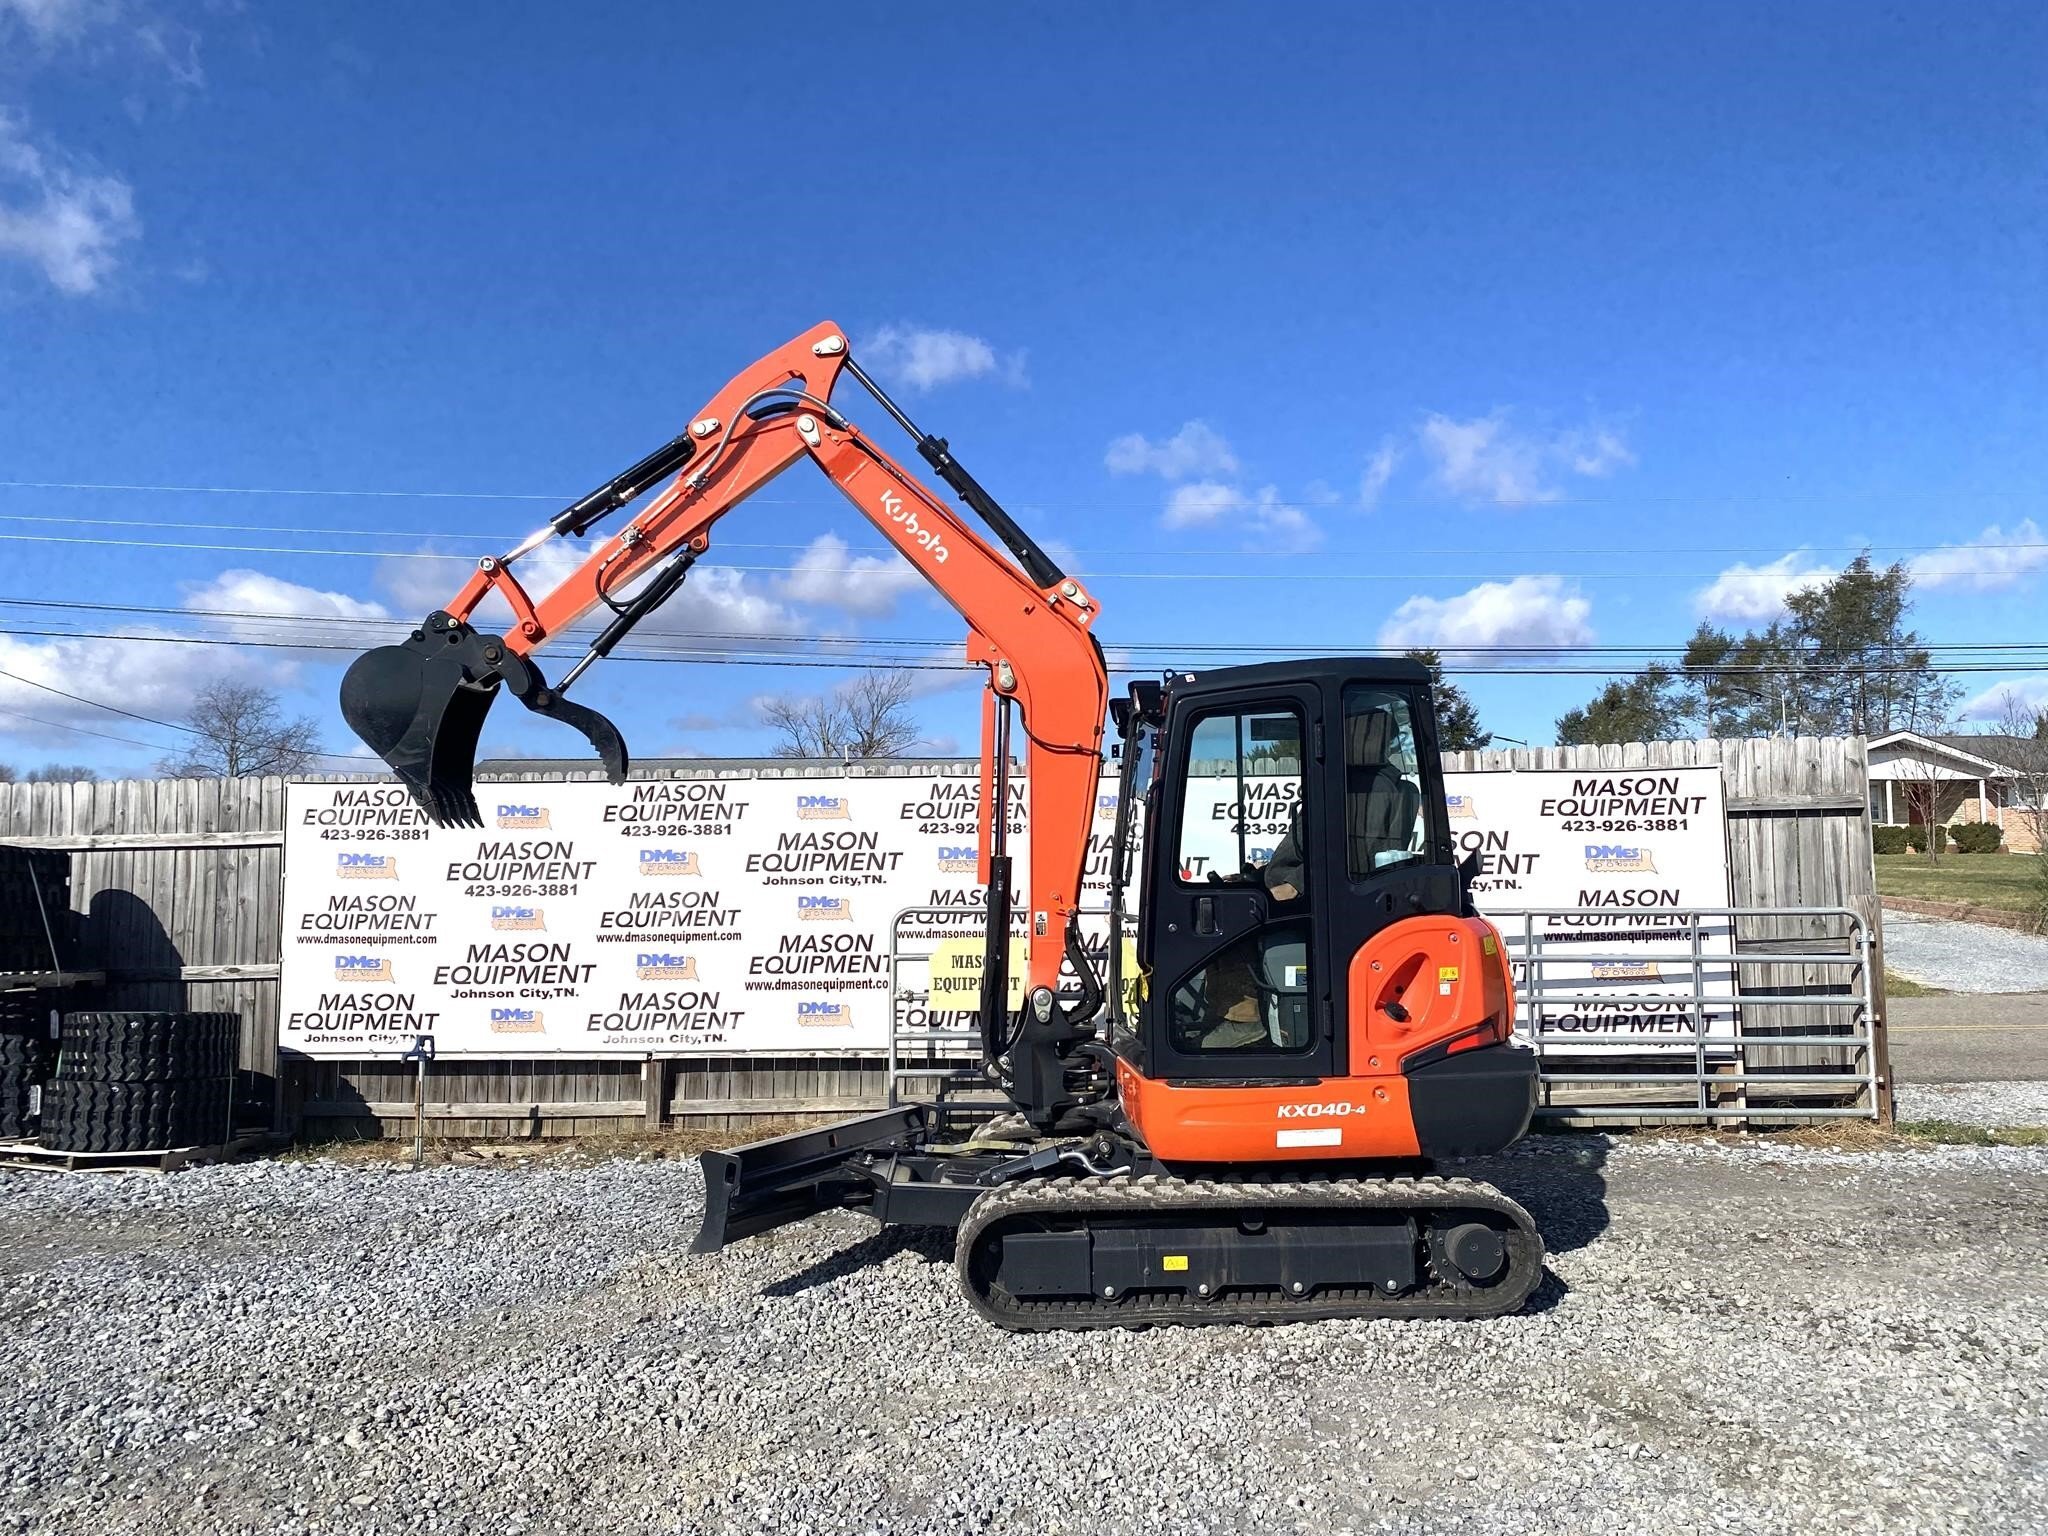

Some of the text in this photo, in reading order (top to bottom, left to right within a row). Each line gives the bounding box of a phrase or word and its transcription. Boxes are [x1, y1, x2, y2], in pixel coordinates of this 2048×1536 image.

[880, 488, 949, 564] Kubota
[633, 783, 726, 802] MASON
[929, 783, 1025, 801] MASN
[1573, 777, 1679, 796] MASON
[603, 801, 749, 822] EQUIPMENT
[1540, 797, 1707, 816] EQUIPMENT
[303, 809, 430, 826] EQUIPMEN
[1562, 819, 1687, 831] 423-926-3881
[320, 829, 428, 840] 423-926-3881
[621, 824, 731, 836] 423-926-3881
[777, 832, 878, 851] MASON
[477, 842, 573, 860] MASON
[938, 847, 978, 860] DMe
[746, 849, 903, 872] EQUIPMENT
[447, 859, 597, 881] EQUIPMENT
[762, 876, 823, 885] Johnson
[465, 884, 577, 896] 423-926-3881
[929, 889, 1021, 906] MASN
[1578, 889, 1680, 906] MASON
[328, 896, 416, 911] MASON
[629, 891, 719, 908] MASON
[301, 914, 437, 930] EQUIPMENT
[600, 910, 741, 928] EQUIPMENT
[297, 934, 436, 947] www.dmasonequipment.com
[596, 931, 741, 944] www.dmasonequipment.com
[779, 934, 874, 953] MASON
[1543, 930, 1710, 943] www.dmasonequipment.cm
[467, 943, 570, 963] MASON
[434, 962, 597, 984] EQUIPMENT
[451, 989, 514, 998] Johnson
[743, 977, 889, 993] www.dmasonequipment.co
[318, 994, 415, 1011] MASON
[619, 992, 720, 1010] MASON
[288, 1013, 440, 1030] EQUIPMENT
[587, 1012, 745, 1031] EQUIPMENT
[304, 1034, 363, 1042] Johnson
[603, 1034, 663, 1045] Johnson
[1277, 1102, 1366, 1118] KX040-4
